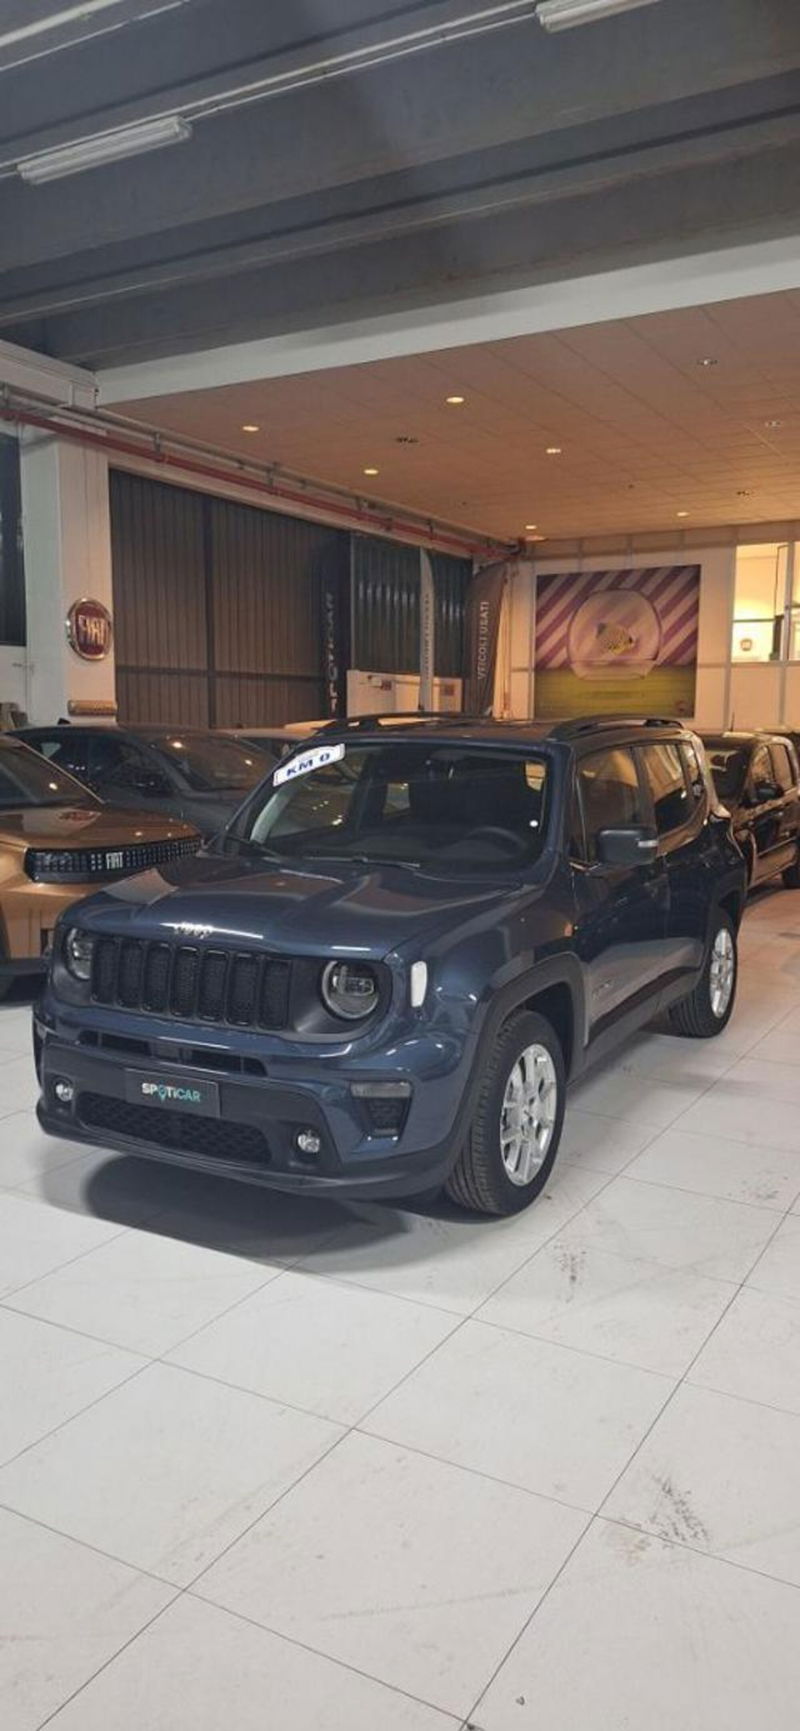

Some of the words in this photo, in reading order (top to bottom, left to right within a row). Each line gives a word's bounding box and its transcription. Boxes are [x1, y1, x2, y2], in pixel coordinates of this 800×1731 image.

[78, 614, 108, 646] FIAT
[286, 759, 314, 777] KM
[106, 852, 123, 869] FIAT
[141, 1082, 201, 1103] SPOTICAR
